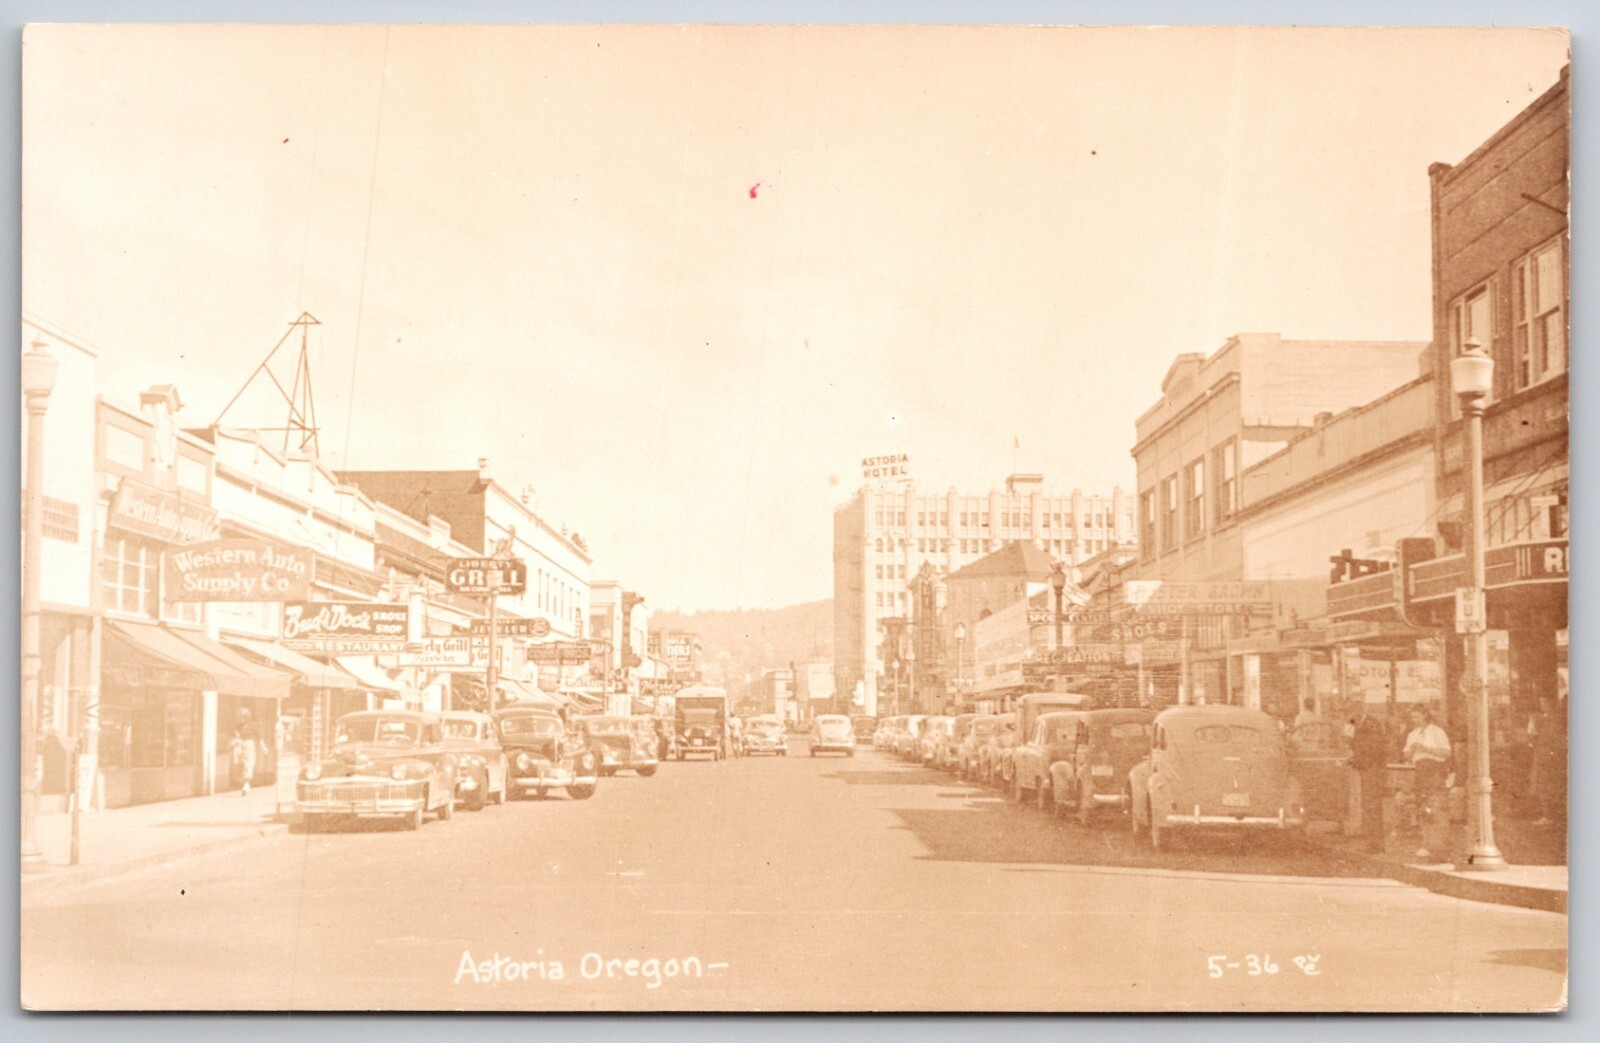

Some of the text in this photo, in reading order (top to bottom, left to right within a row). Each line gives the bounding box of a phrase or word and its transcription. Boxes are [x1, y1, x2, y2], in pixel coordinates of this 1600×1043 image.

[861, 454, 909, 467] ASTORIA
[863, 467, 906, 478] HOTEL
[173, 547, 306, 574] Western Auto
[184, 571, 290, 596] Supply Co
[373, 611, 407, 622] SMOKE
[1464, 604, 1473, 617] U
[376, 624, 403, 634] SHOP
[1112, 622, 1167, 641] SHOES
[315, 641, 406, 652] RESTAURANT
[443, 639, 468, 652] Grill
